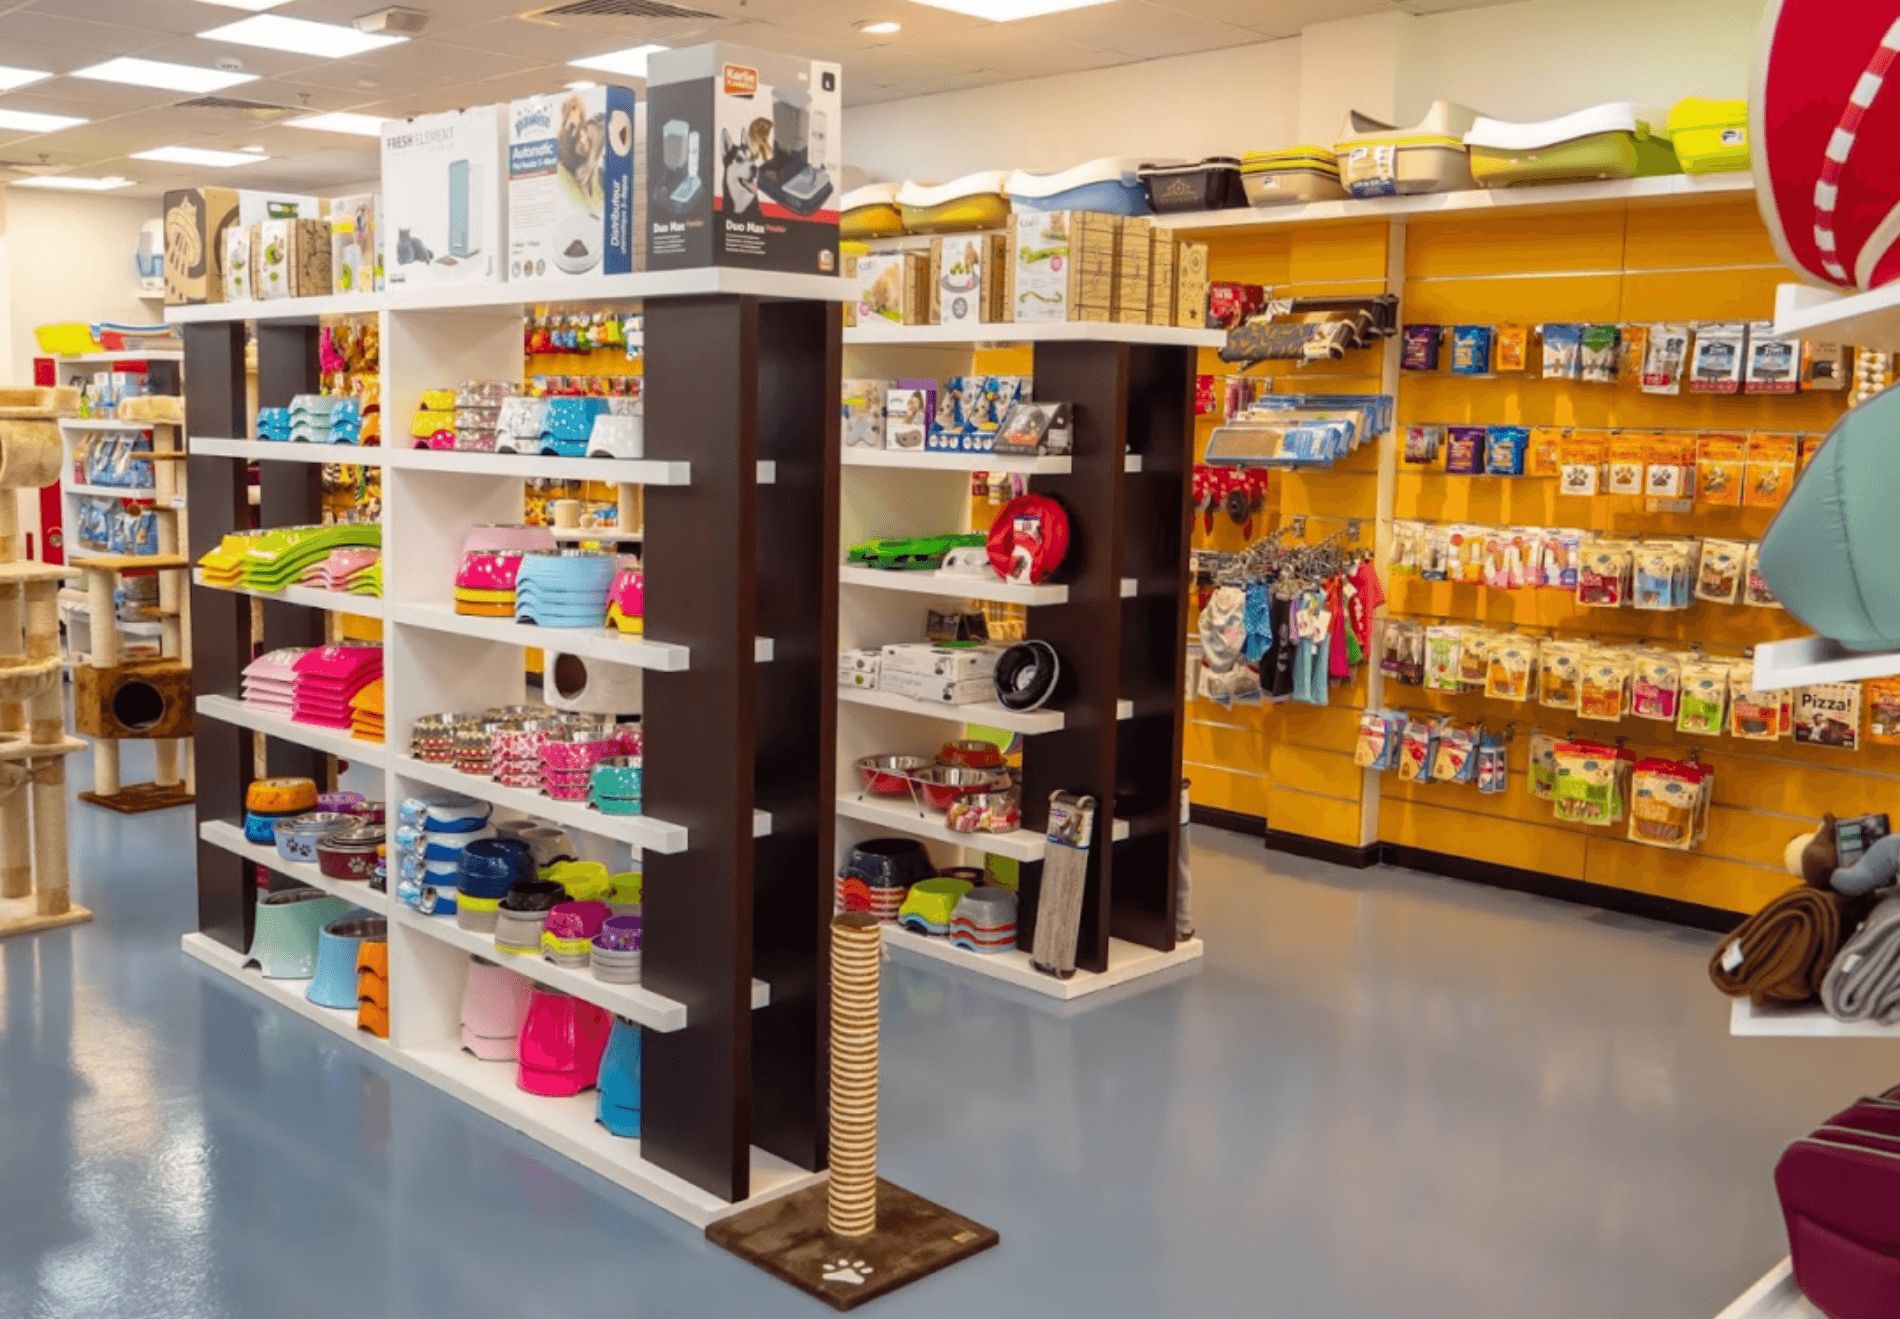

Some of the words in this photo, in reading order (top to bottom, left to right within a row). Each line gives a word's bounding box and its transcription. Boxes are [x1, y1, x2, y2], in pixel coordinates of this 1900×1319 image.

[387, 135, 413, 151] FRESH
[415, 126, 454, 146] ELEMENT
[512, 142, 554, 160] Automatic
[610, 179, 620, 248] Distributeur
[653, 222, 668, 234] Duo
[670, 220, 685, 232] Max
[725, 218, 745, 233] Duo
[747, 221, 766, 235] Max
[1802, 694, 1851, 713] Pizza!
